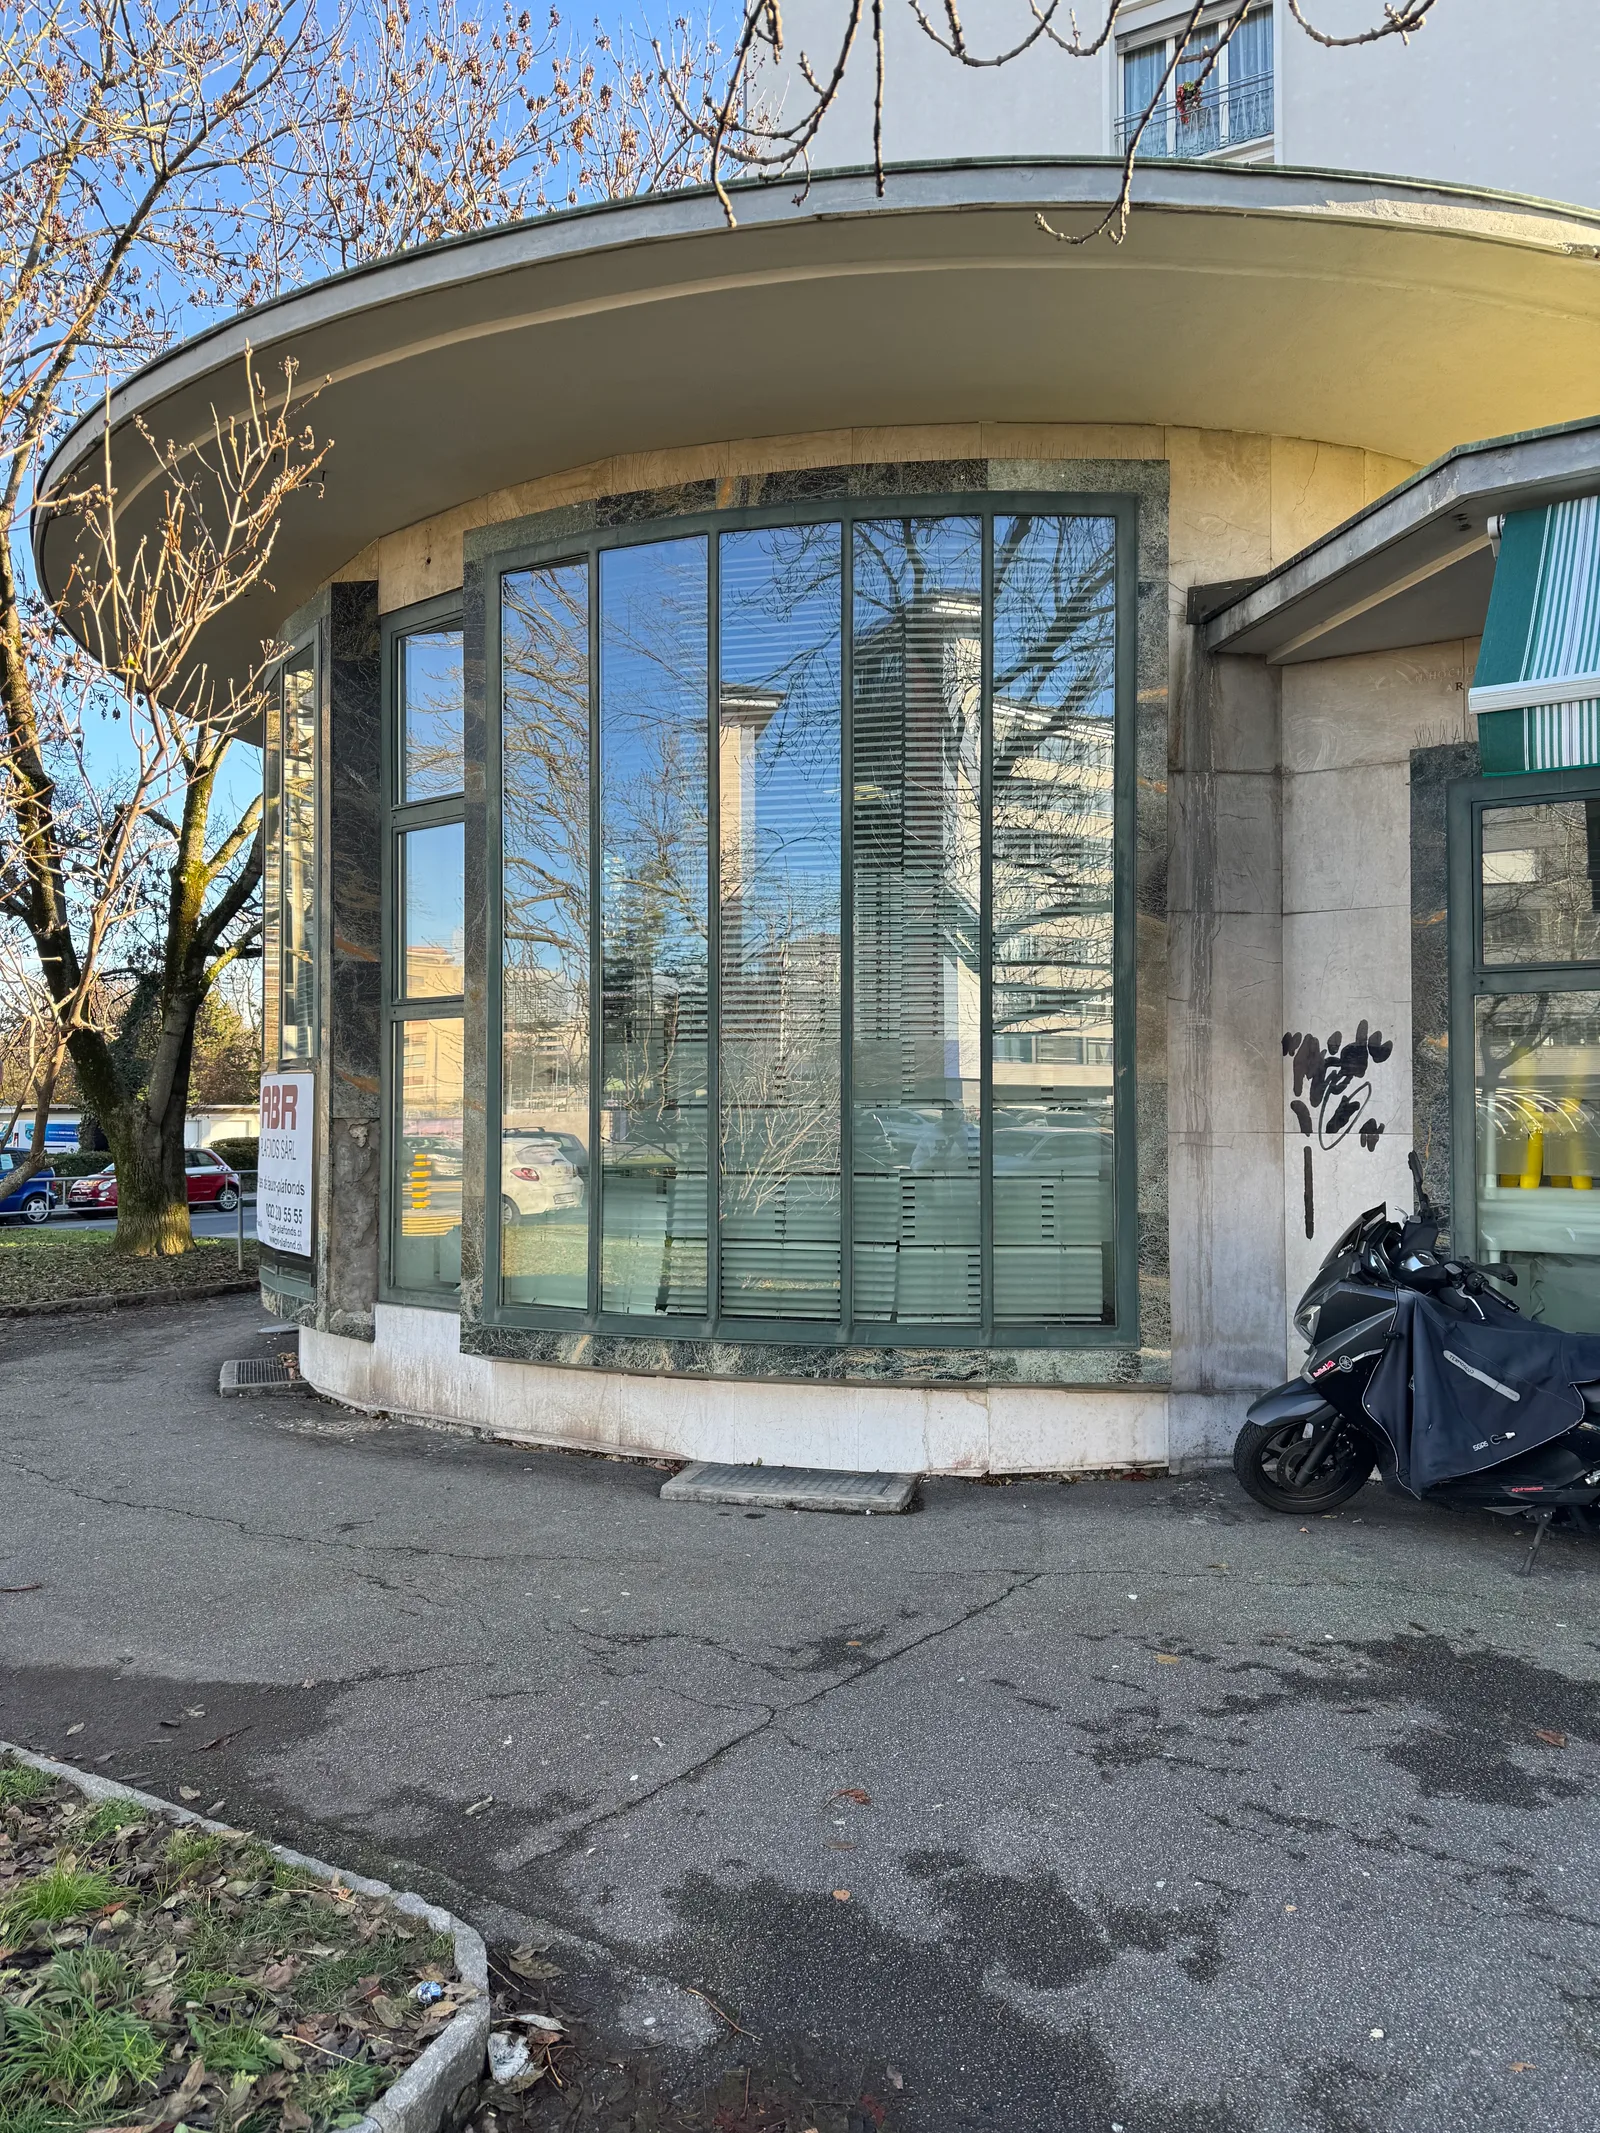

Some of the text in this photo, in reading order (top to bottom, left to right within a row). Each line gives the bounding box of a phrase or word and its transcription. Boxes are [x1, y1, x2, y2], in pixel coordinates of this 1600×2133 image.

[261, 1084, 299, 1131] ABR
[283, 1207, 292, 1222] 55
[293, 1208, 303, 1224] 55
